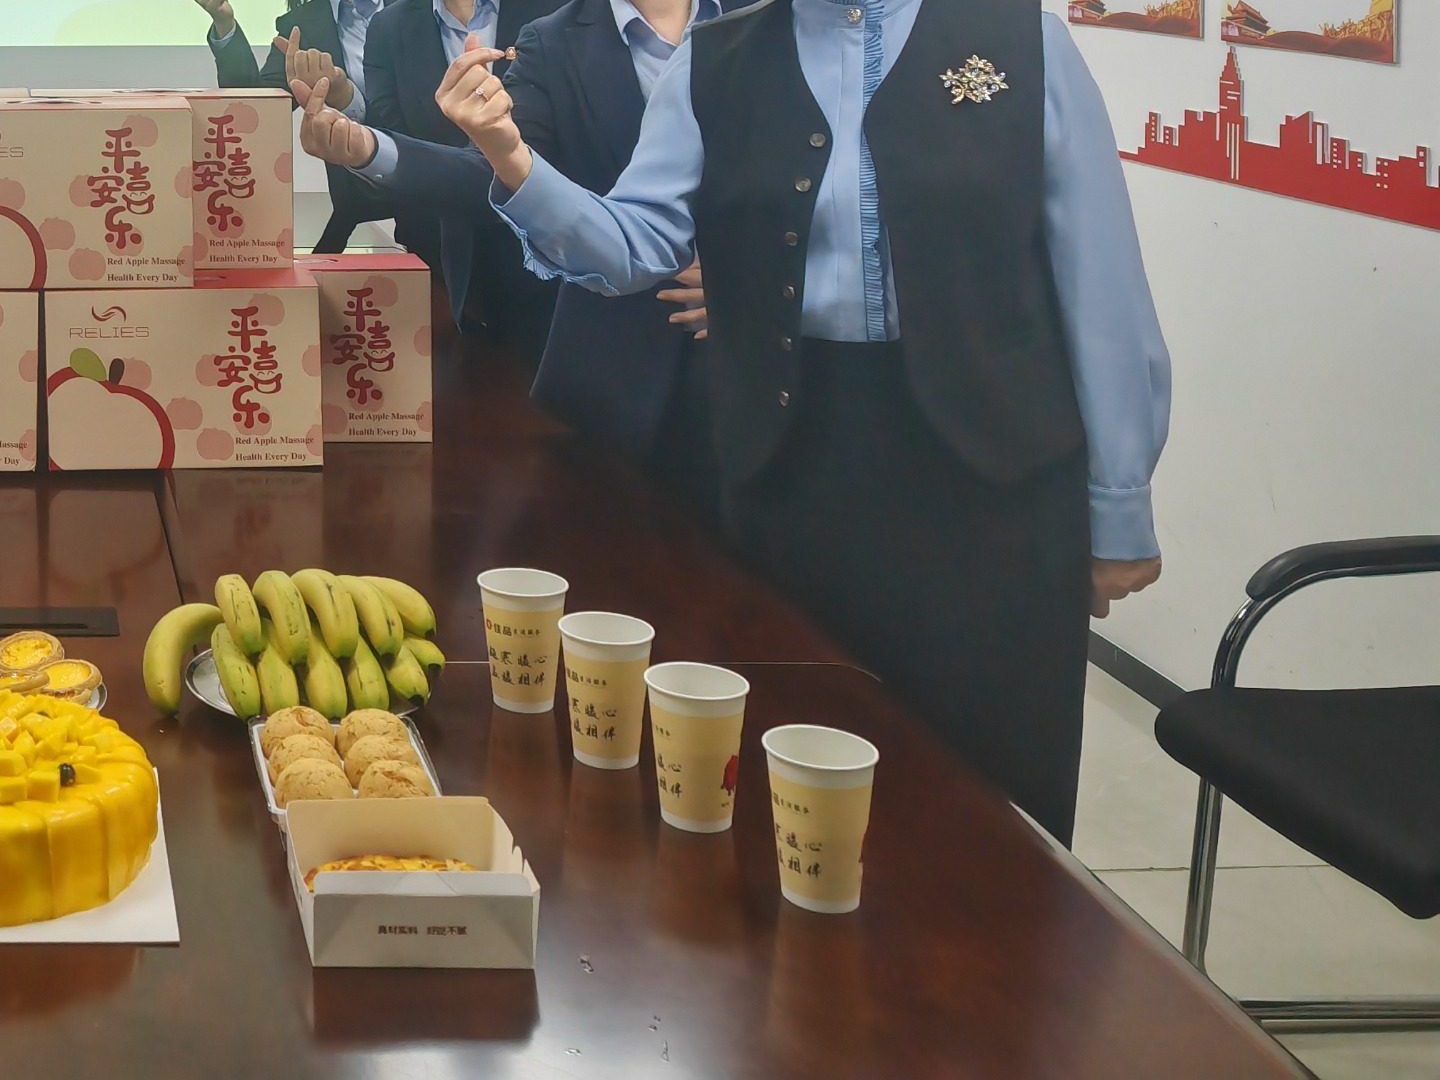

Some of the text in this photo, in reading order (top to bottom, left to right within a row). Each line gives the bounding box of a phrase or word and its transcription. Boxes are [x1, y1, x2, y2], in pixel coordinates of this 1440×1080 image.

[209, 239, 285, 249] Red Apple Massage
[107, 257, 185, 267] Red Apple Massage
[209, 255, 278, 264] Health Every Day
[107, 274, 178, 283] Health Every Day
[69, 326, 150, 339] RELIES
[349, 412, 424, 422] Red Apple Massage
[349, 427, 417, 437] Health Every Day
[235, 435, 314, 446] Red Apple Massage
[4, 456, 20, 465] Day
[235, 452, 307, 462] Health Every Day
